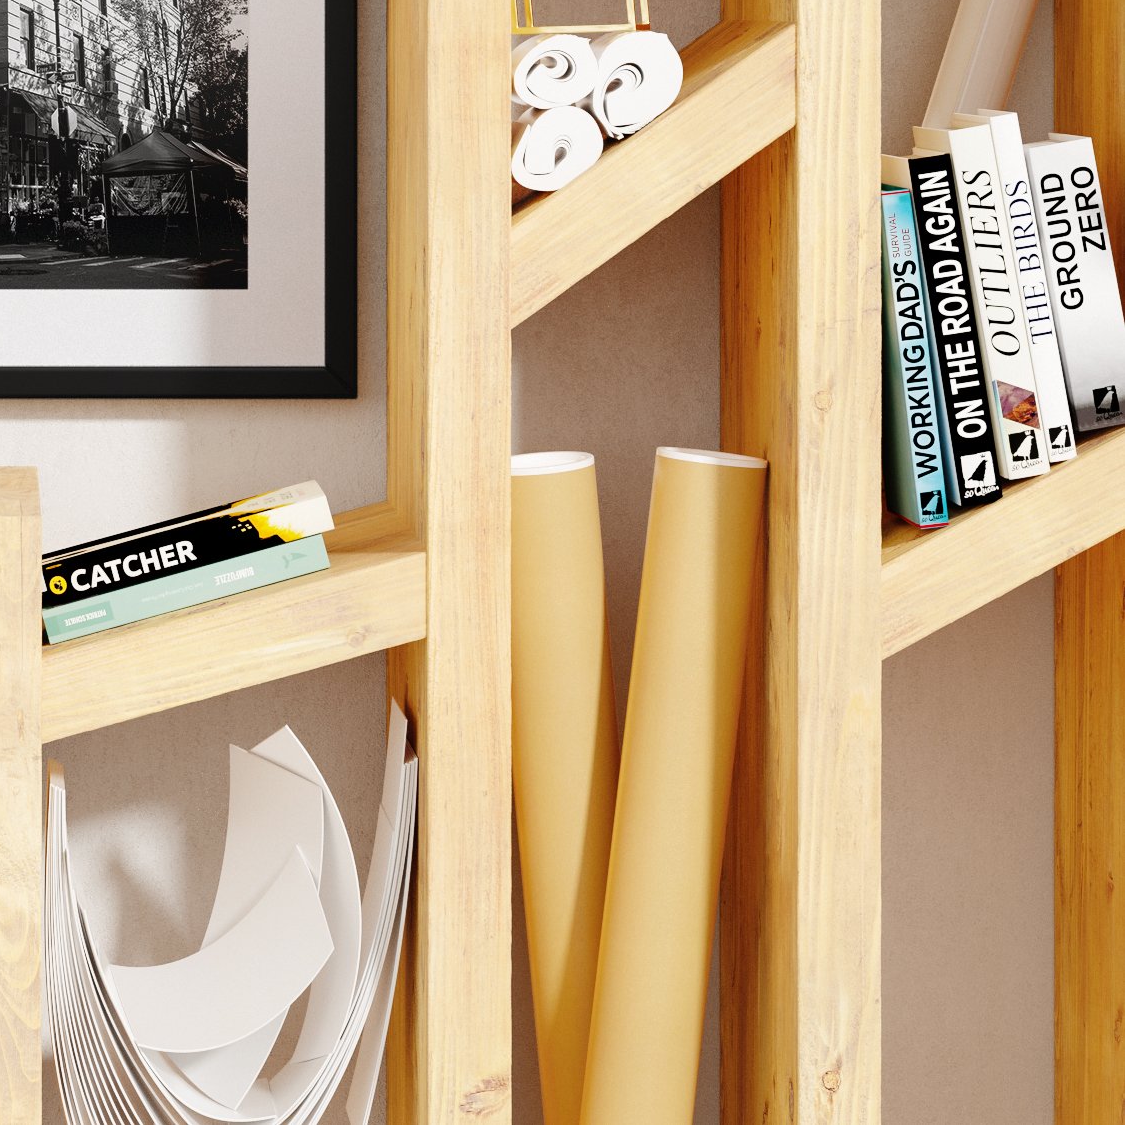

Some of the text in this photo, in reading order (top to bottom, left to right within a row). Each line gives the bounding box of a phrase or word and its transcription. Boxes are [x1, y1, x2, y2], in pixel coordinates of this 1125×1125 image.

[888, 212, 900, 258] SURVIVAL
[901, 228, 912, 257] GUIDE
[962, 169, 1021, 357] OUTLIERS
[1005, 180, 1053, 345] THE BIRDS
[1041, 173, 1084, 311] GROUND
[1070, 165, 1107, 253] ZERO
[918, 169, 987, 440] ON THE ROAD AGAIN
[901, 345, 938, 479] WORKING
[70, 540, 198, 592] CATCHER
